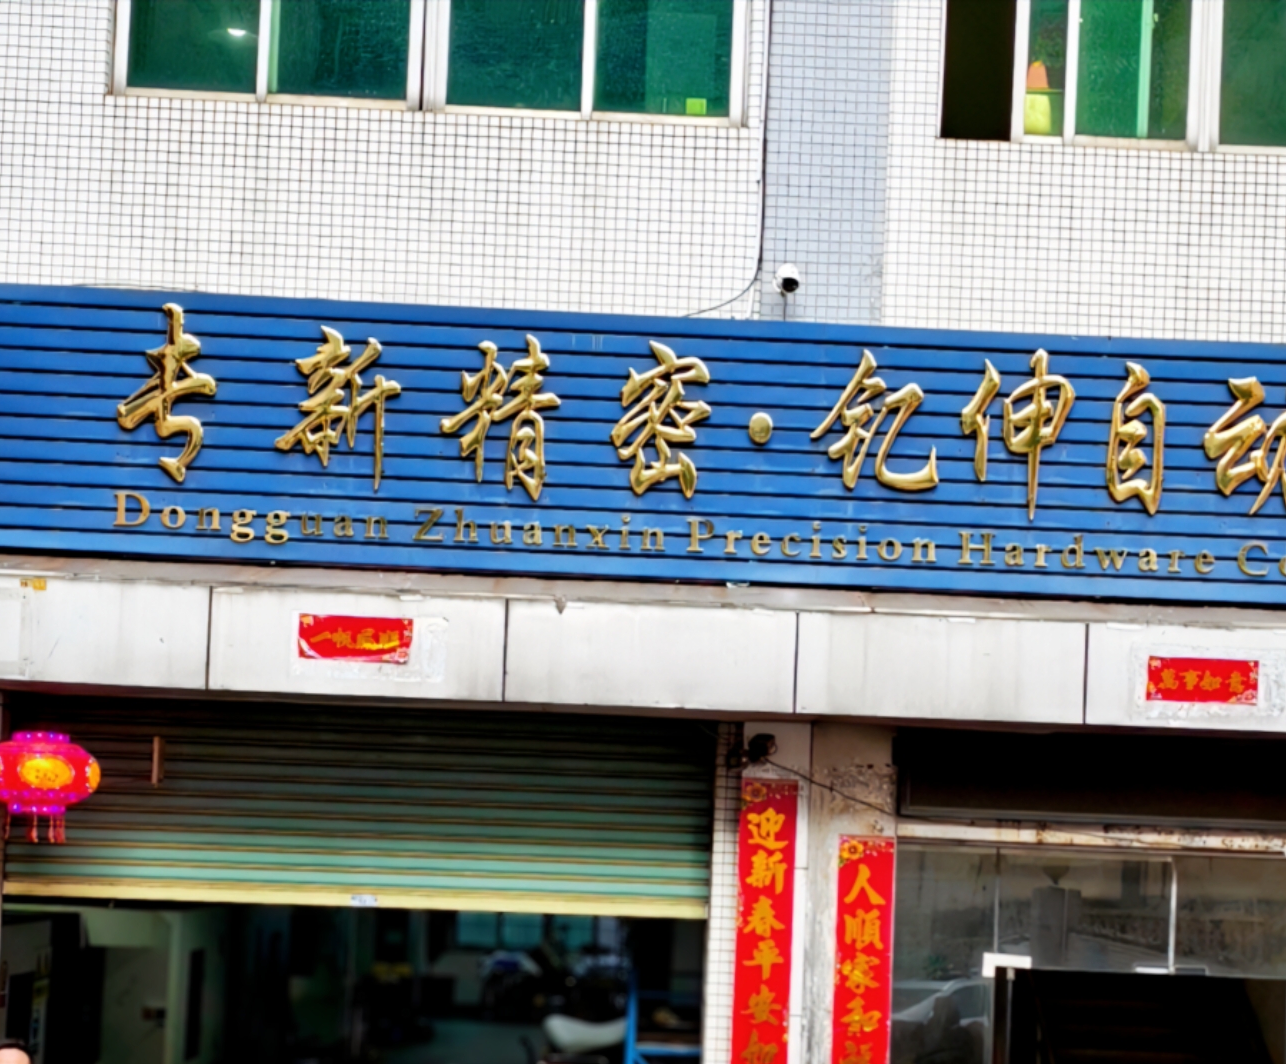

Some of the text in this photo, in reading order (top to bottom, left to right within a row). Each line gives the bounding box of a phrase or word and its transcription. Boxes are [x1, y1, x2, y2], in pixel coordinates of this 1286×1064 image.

[114, 491, 389, 544] Dongguan
[414, 507, 666, 553] Zhuanxin
[687, 517, 937, 563] Precision
[957, 530, 1215, 575] Hardware
